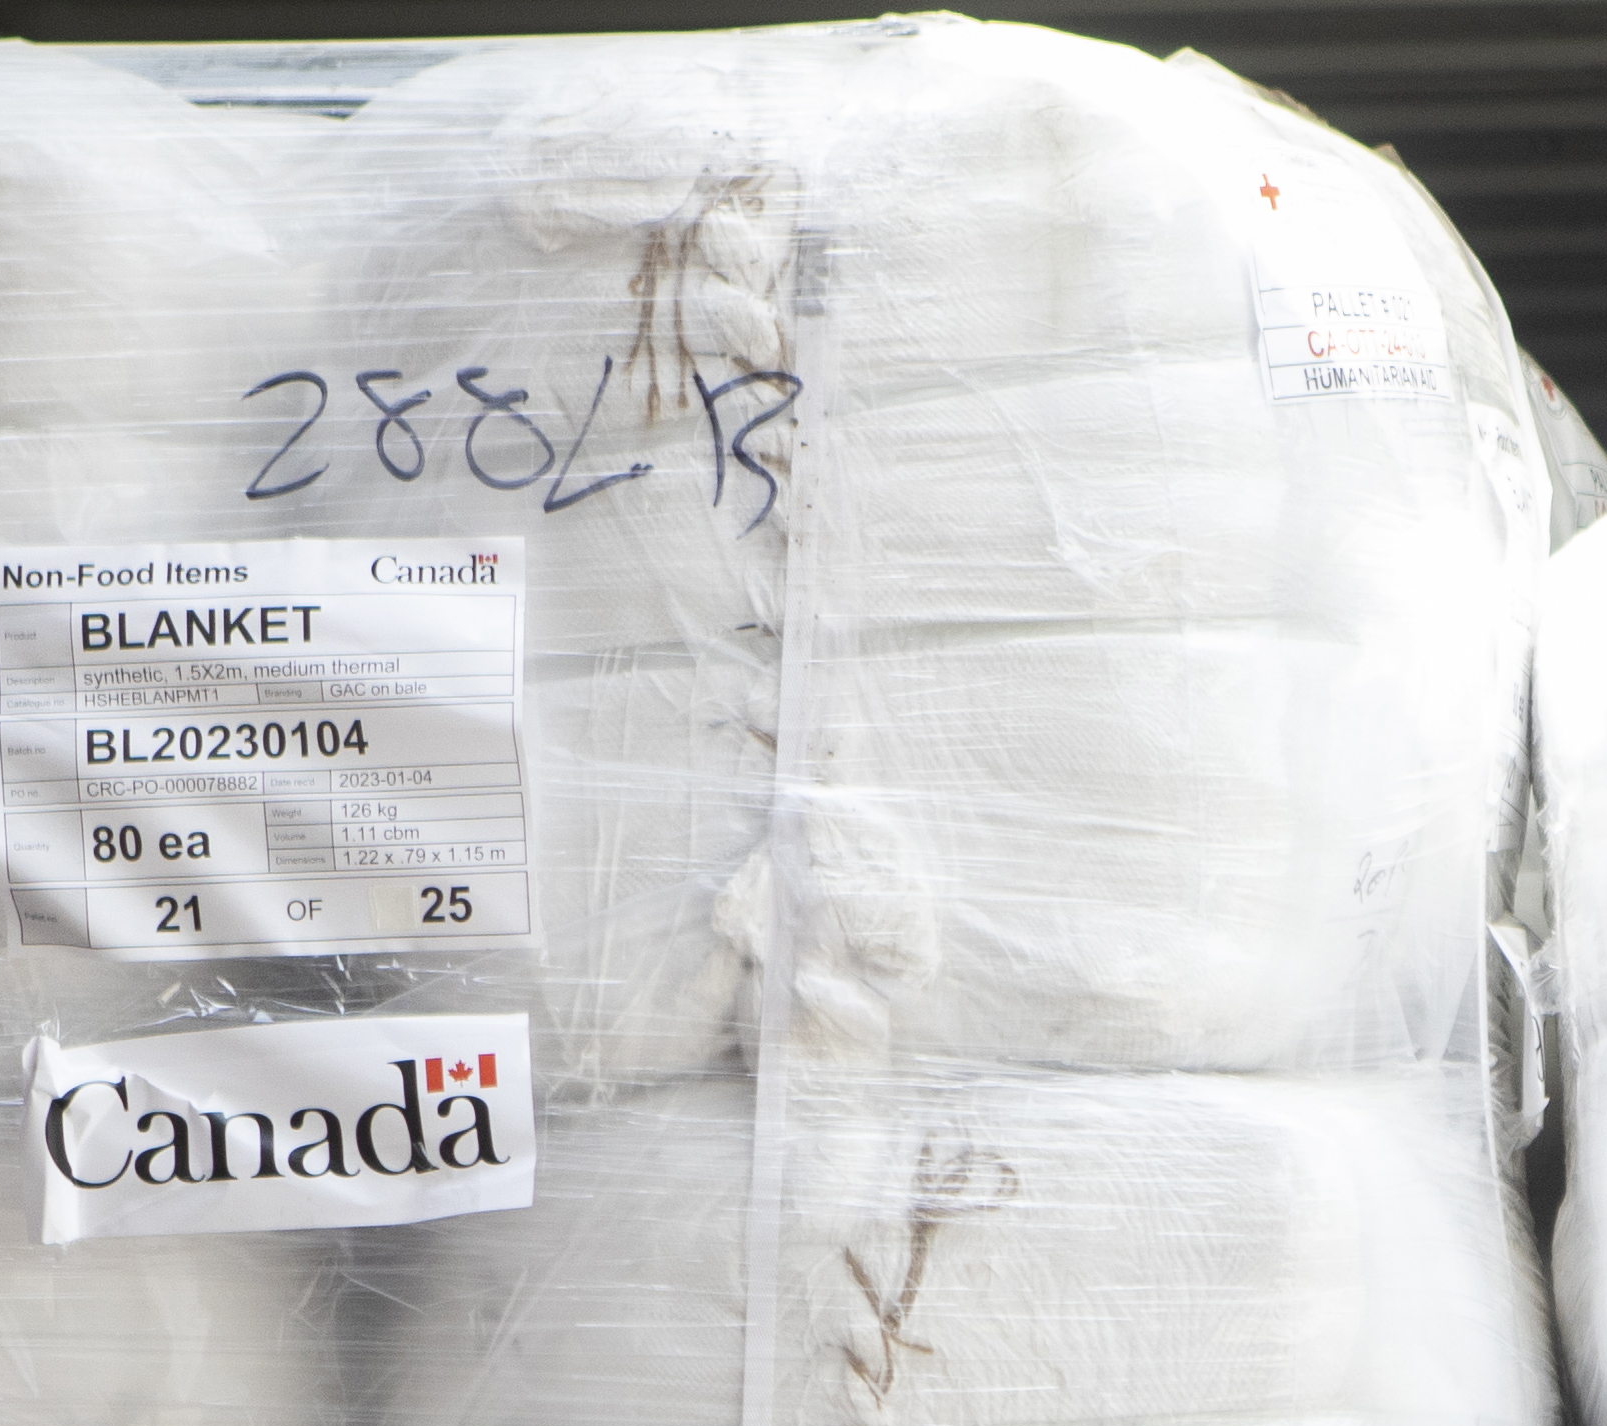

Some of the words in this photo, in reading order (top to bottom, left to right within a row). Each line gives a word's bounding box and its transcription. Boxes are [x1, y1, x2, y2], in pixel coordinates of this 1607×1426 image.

[1311, 291, 1378, 318] PALLET
[1304, 364, 1419, 391] HUMANITARIAN
[1420, 368, 1438, 391] AID
[2, 562, 154, 591] Non-Food
[166, 562, 249, 585] Items
[370, 554, 500, 585] Canada
[4, 631, 37, 642] Product
[81, 605, 322, 653] BLANKET
[83, 666, 169, 695] synthetic,
[174, 663, 249, 683] 1.5X2m,
[253, 659, 325, 679] medium
[332, 657, 400, 676] thermal
[329, 682, 366, 698] GAC
[370, 683, 390, 696] on
[394, 680, 427, 695] bale
[83, 688, 220, 709] HSHEBLANPMT1
[86, 719, 369, 766] BL20230104
[86, 775, 258, 799] CRC-PO-000078882
[339, 769, 433, 789] 2023-01-04
[341, 803, 372, 819] 126
[377, 802, 398, 821] kg
[92, 824, 143, 863] 80
[158, 830, 212, 861] ea
[342, 826, 377, 844] 1.11
[383, 825, 420, 841] cbm
[342, 849, 380, 867] 1.22
[384, 852, 395, 865] x
[400, 848, 427, 865] .79
[430, 851, 442, 863] x
[448, 846, 485, 864] 1.15
[490, 848, 506, 861] m
[154, 894, 203, 934] 21
[286, 899, 324, 922] OF
[420, 885, 474, 925] 25
[45, 1059, 512, 1190] Canada
